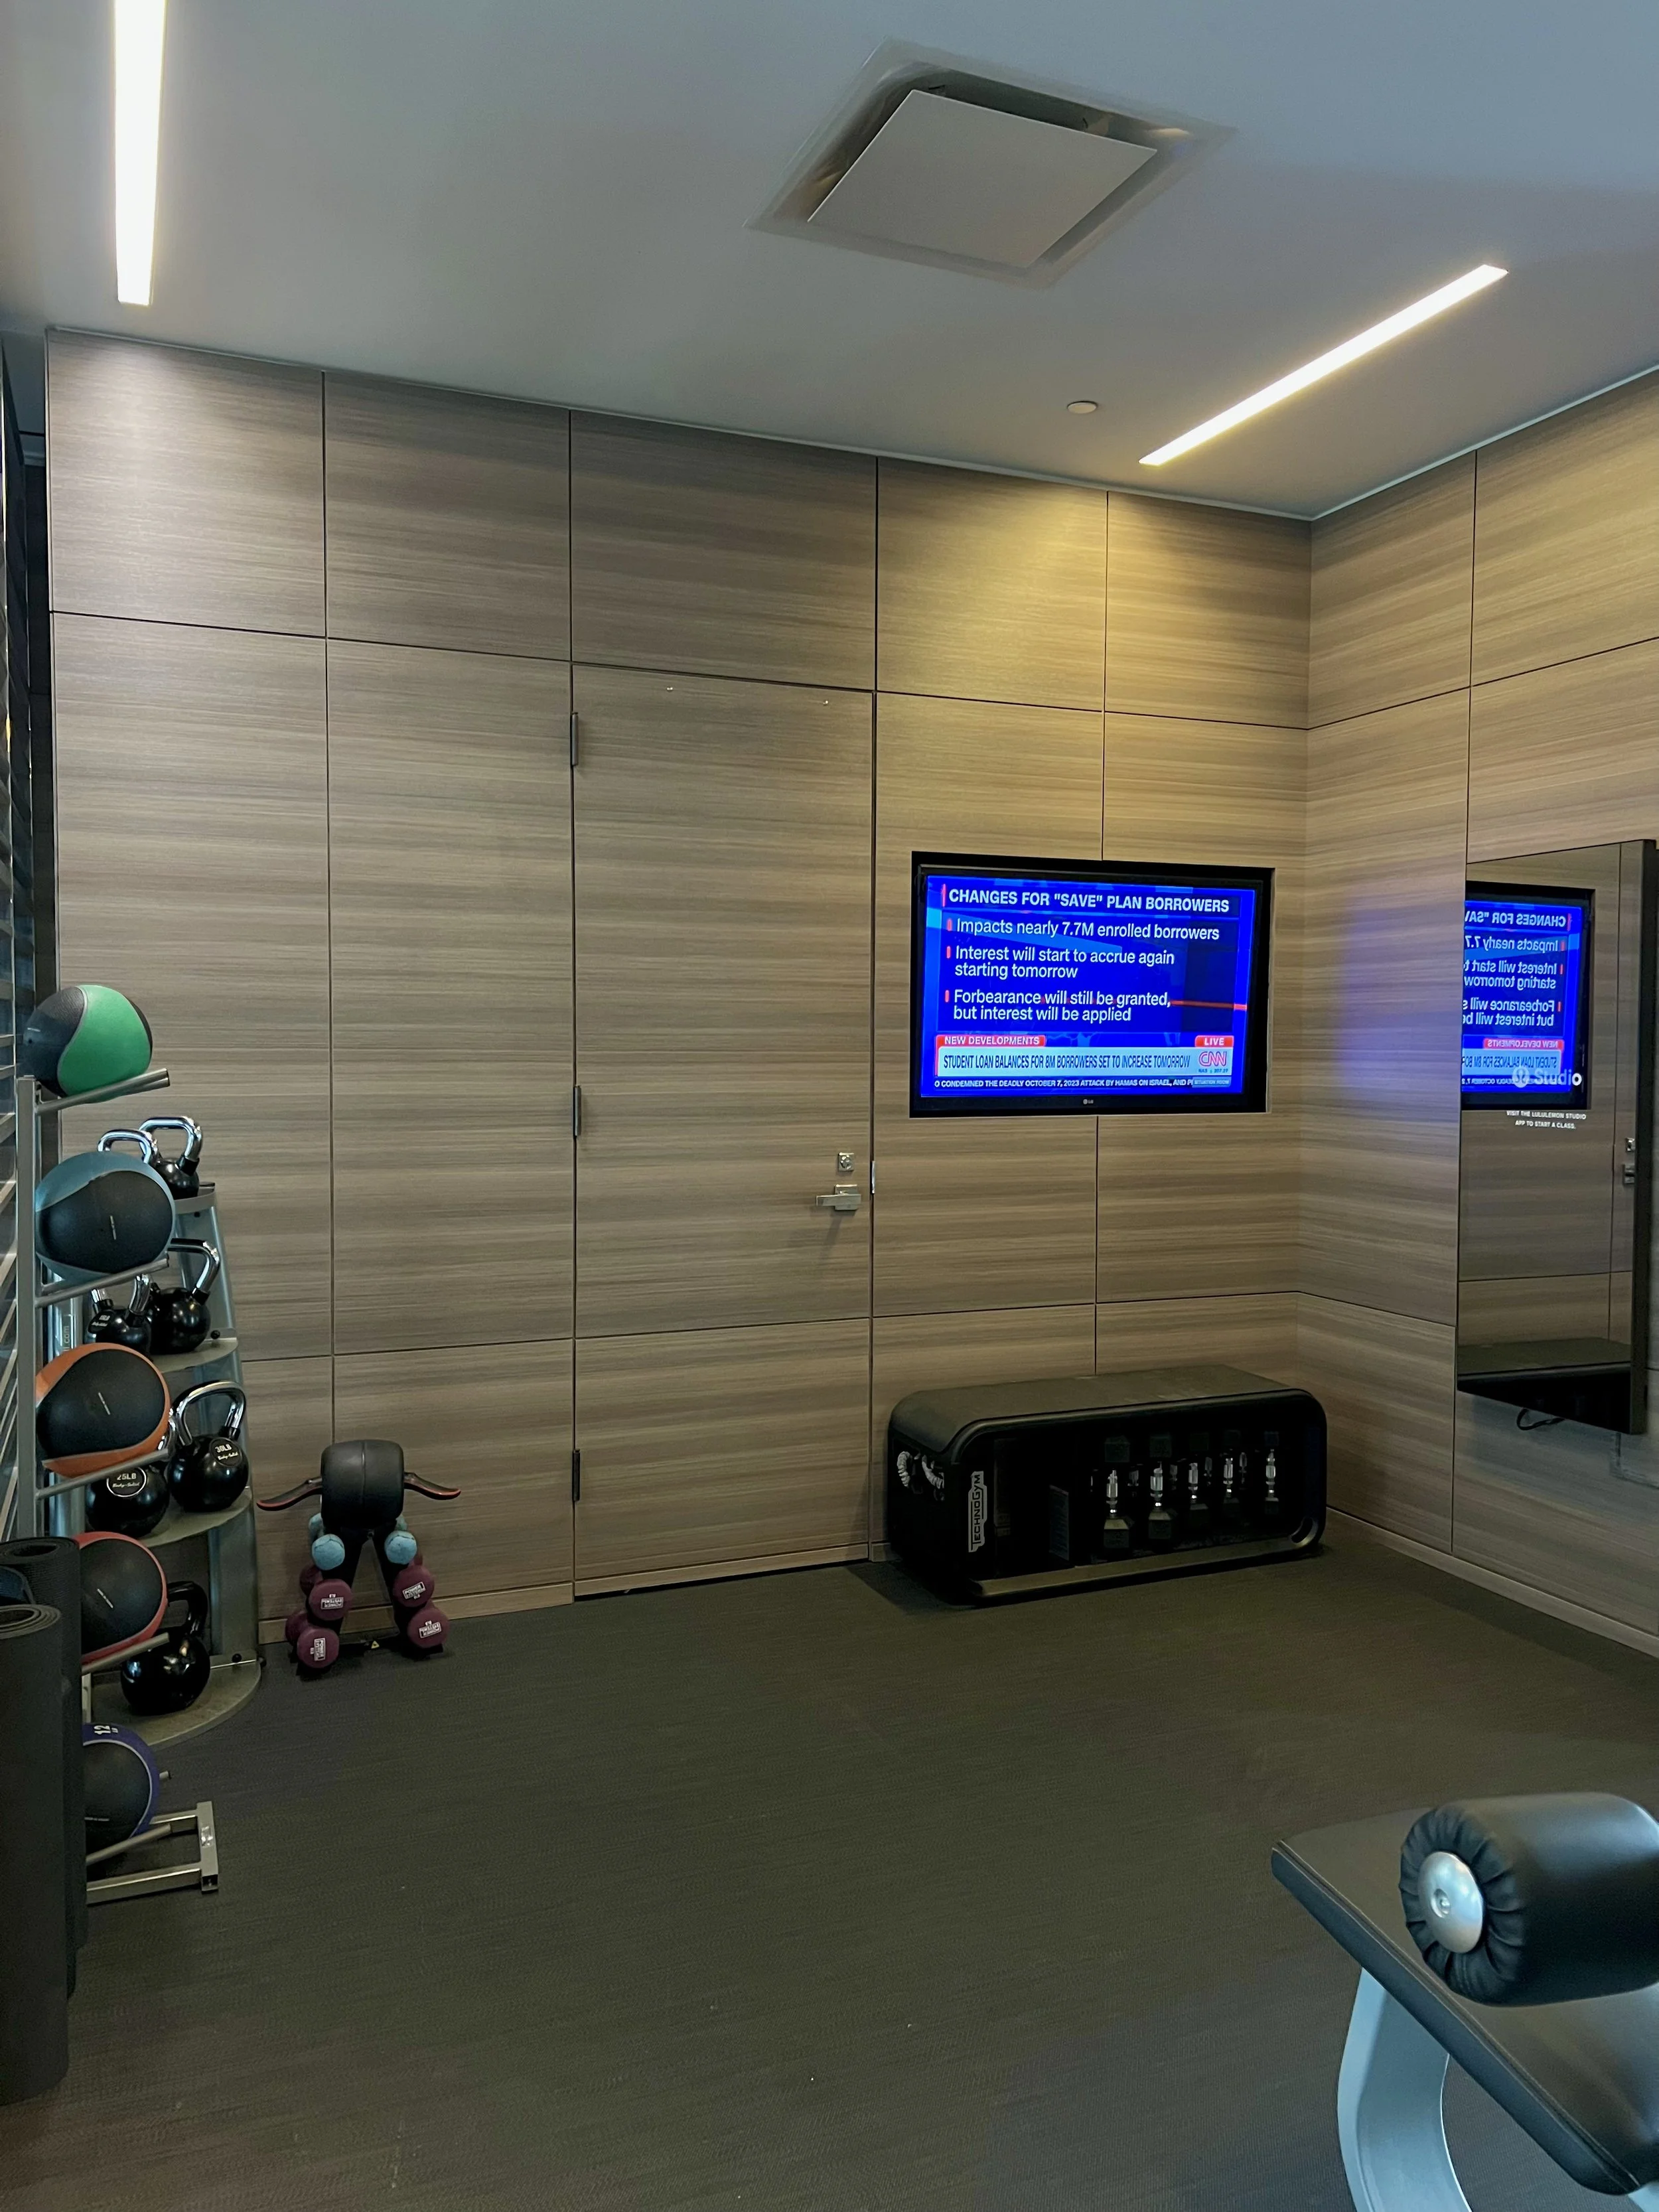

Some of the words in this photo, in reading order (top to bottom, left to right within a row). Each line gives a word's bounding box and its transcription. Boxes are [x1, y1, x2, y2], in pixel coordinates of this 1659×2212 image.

[949, 889, 1017, 905] CHANGES
[1022, 892, 1050, 906] FOR
[1054, 893, 1102, 907] "SAVE"
[1107, 895, 1141, 909] PLAN
[1145, 897, 1229, 913] BORROWERS
[957, 918, 1013, 936] Impacts
[1017, 920, 1058, 938] nearly
[1062, 921, 1094, 936] 7.7M
[1098, 923, 1151, 938] enrolled
[1154, 924, 1219, 940] borrowers
[956, 945, 1009, 960] Interest
[1013, 946, 1035, 961] will
[1039, 948, 1070, 962] start
[1073, 949, 1087, 962] to
[1090, 952, 1135, 963] accrue
[1139, 950, 1175, 966] again
[955, 962, 1008, 980] starting
[1012, 964, 1078, 978] tomorrow
[954, 989, 1041, 1004] Forbearance
[1045, 990, 1067, 1004] will
[1070, 991, 1092, 1005] still
[1096, 992, 1114, 1005] be
[1117, 992, 1171, 1008] granted,
[954, 1005, 977, 1019] but
[981, 1005, 1033, 1020] interest
[1036, 1006, 1058, 1021] will
[1062, 1007, 1078, 1021] be
[1082, 1007, 1131, 1023] applied
[944, 1036, 966, 1045] NEW
[969, 1036, 1040, 1045] DEVELOPMENTS
[1204, 1037, 1224, 1046] LIVE
[944, 1055, 974, 1069] STUDENT
[975, 1055, 994, 1069] LOAN
[995, 1055, 1029, 1069] BALANCES
[1031, 1055, 1044, 1069] FOR
[1045, 1055, 1055, 1069] 8M
[1057, 1055, 1097, 1068] BORROWERS
[1099, 1055, 1110, 1068] SET
[1112, 1055, 1119, 1068] TO
[1121, 1055, 1151, 1068] INCREASE
[1154, 1055, 1190, 1068] TOMORROW
[1198, 1051, 1227, 1067] CNN
[1534, 1068, 1582, 1086] Studio
[215, 1443, 232, 1453] 30LB
[94, 1726, 111, 1735] 12
